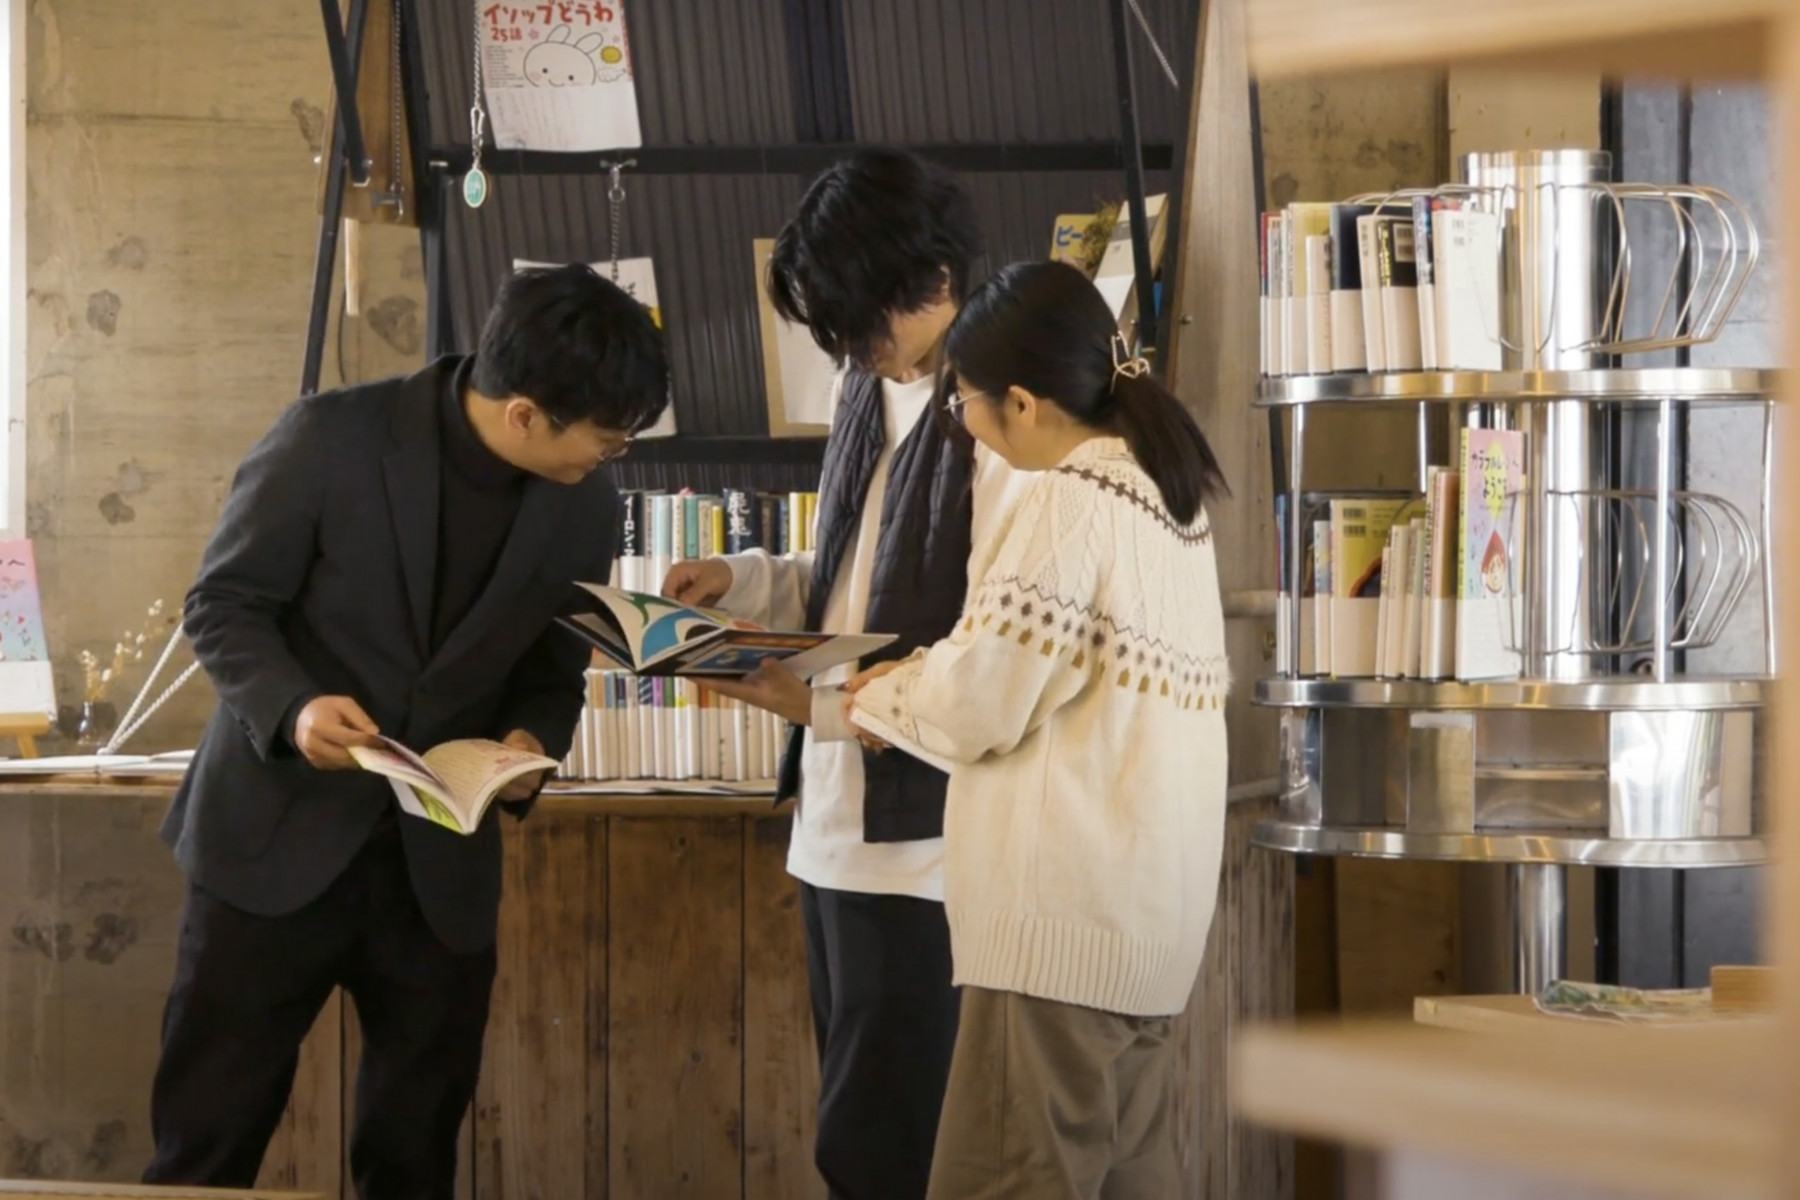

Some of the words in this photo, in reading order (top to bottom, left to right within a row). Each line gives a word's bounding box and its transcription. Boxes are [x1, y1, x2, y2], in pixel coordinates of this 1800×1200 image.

[484, 0, 613, 26] イソップどうわ
